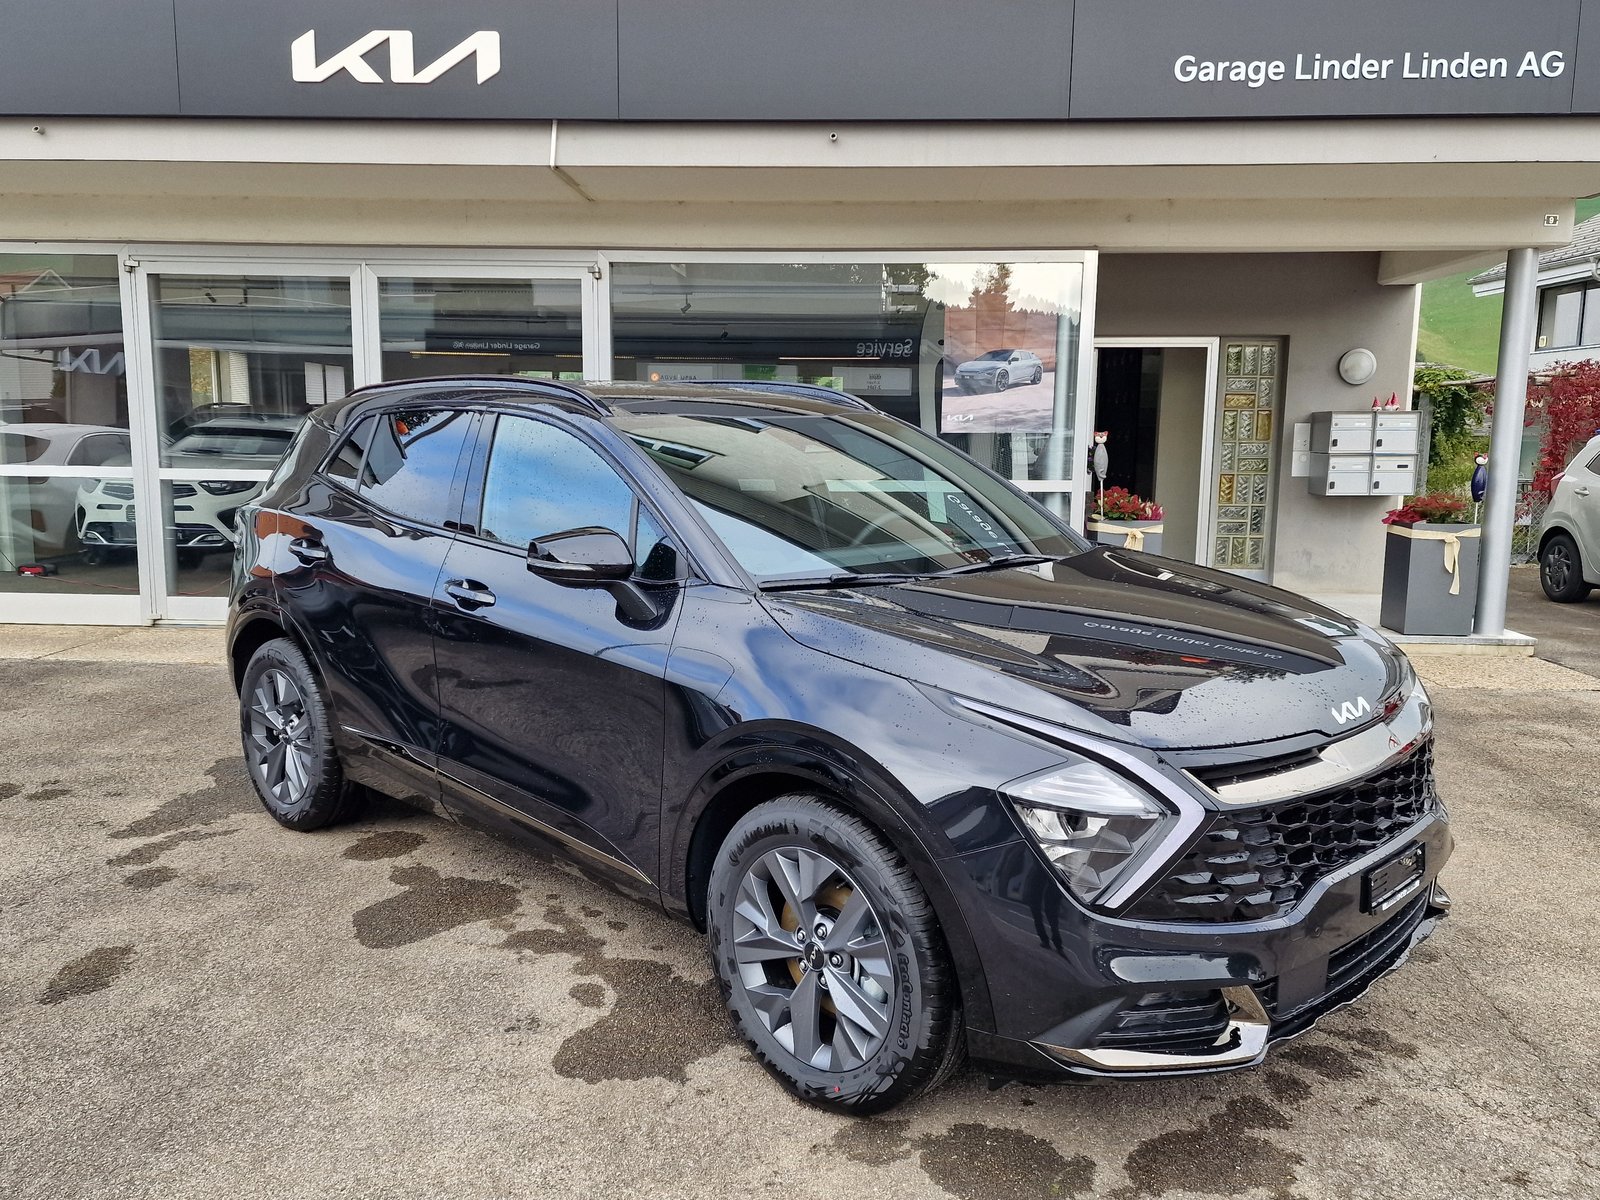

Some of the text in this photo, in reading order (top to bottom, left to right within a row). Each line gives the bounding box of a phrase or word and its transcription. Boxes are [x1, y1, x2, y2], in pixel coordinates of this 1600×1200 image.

[291, 29, 501, 85] KIA
[1174, 50, 1566, 88] Garage Linder Linden AG
[1549, 216, 1554, 224] 9
[946, 414, 974, 422] KIA
[1331, 696, 1371, 725] KIA
[897, 952, 914, 1036] EcoContact
